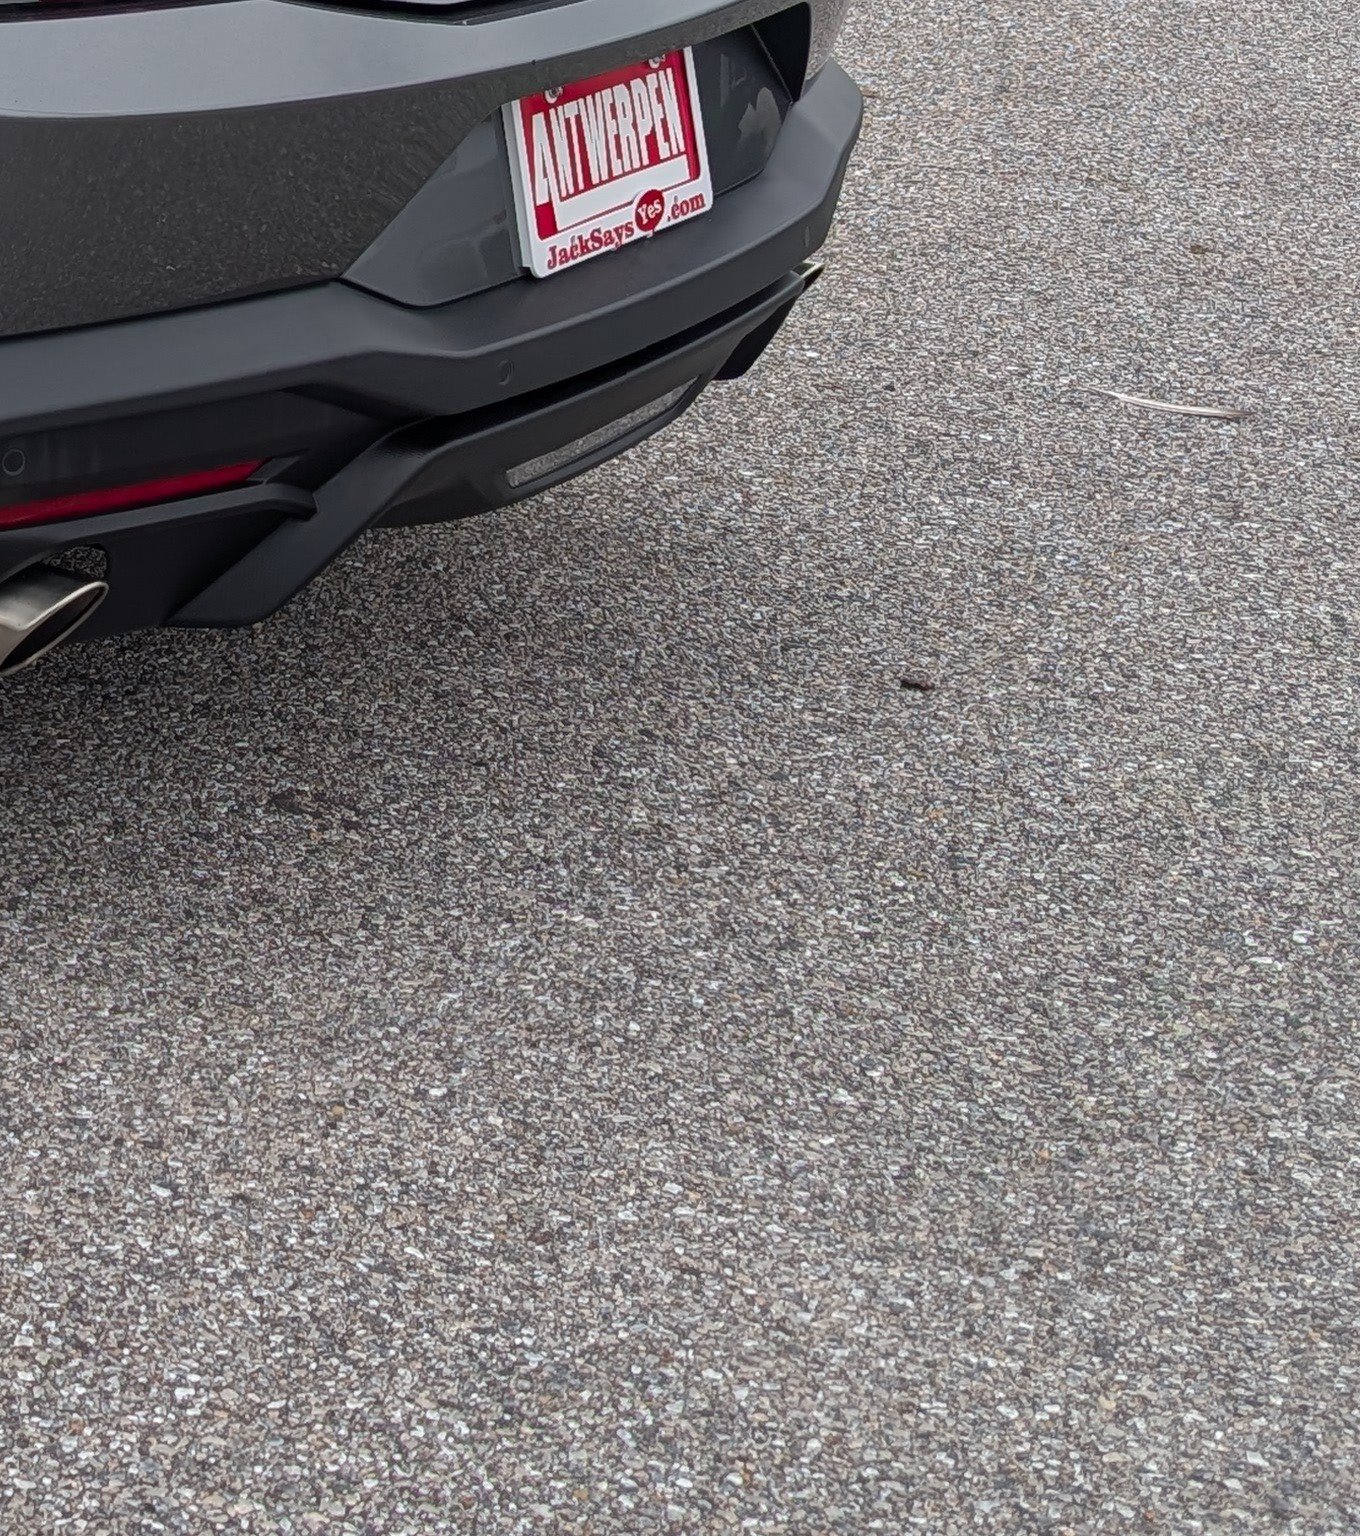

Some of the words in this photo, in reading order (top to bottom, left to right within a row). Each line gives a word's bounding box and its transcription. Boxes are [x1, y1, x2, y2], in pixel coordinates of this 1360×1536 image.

[532, 67, 686, 207] ANTWERPEN
[547, 221, 634, 270] JackSays
[637, 198, 663, 225] Yes
